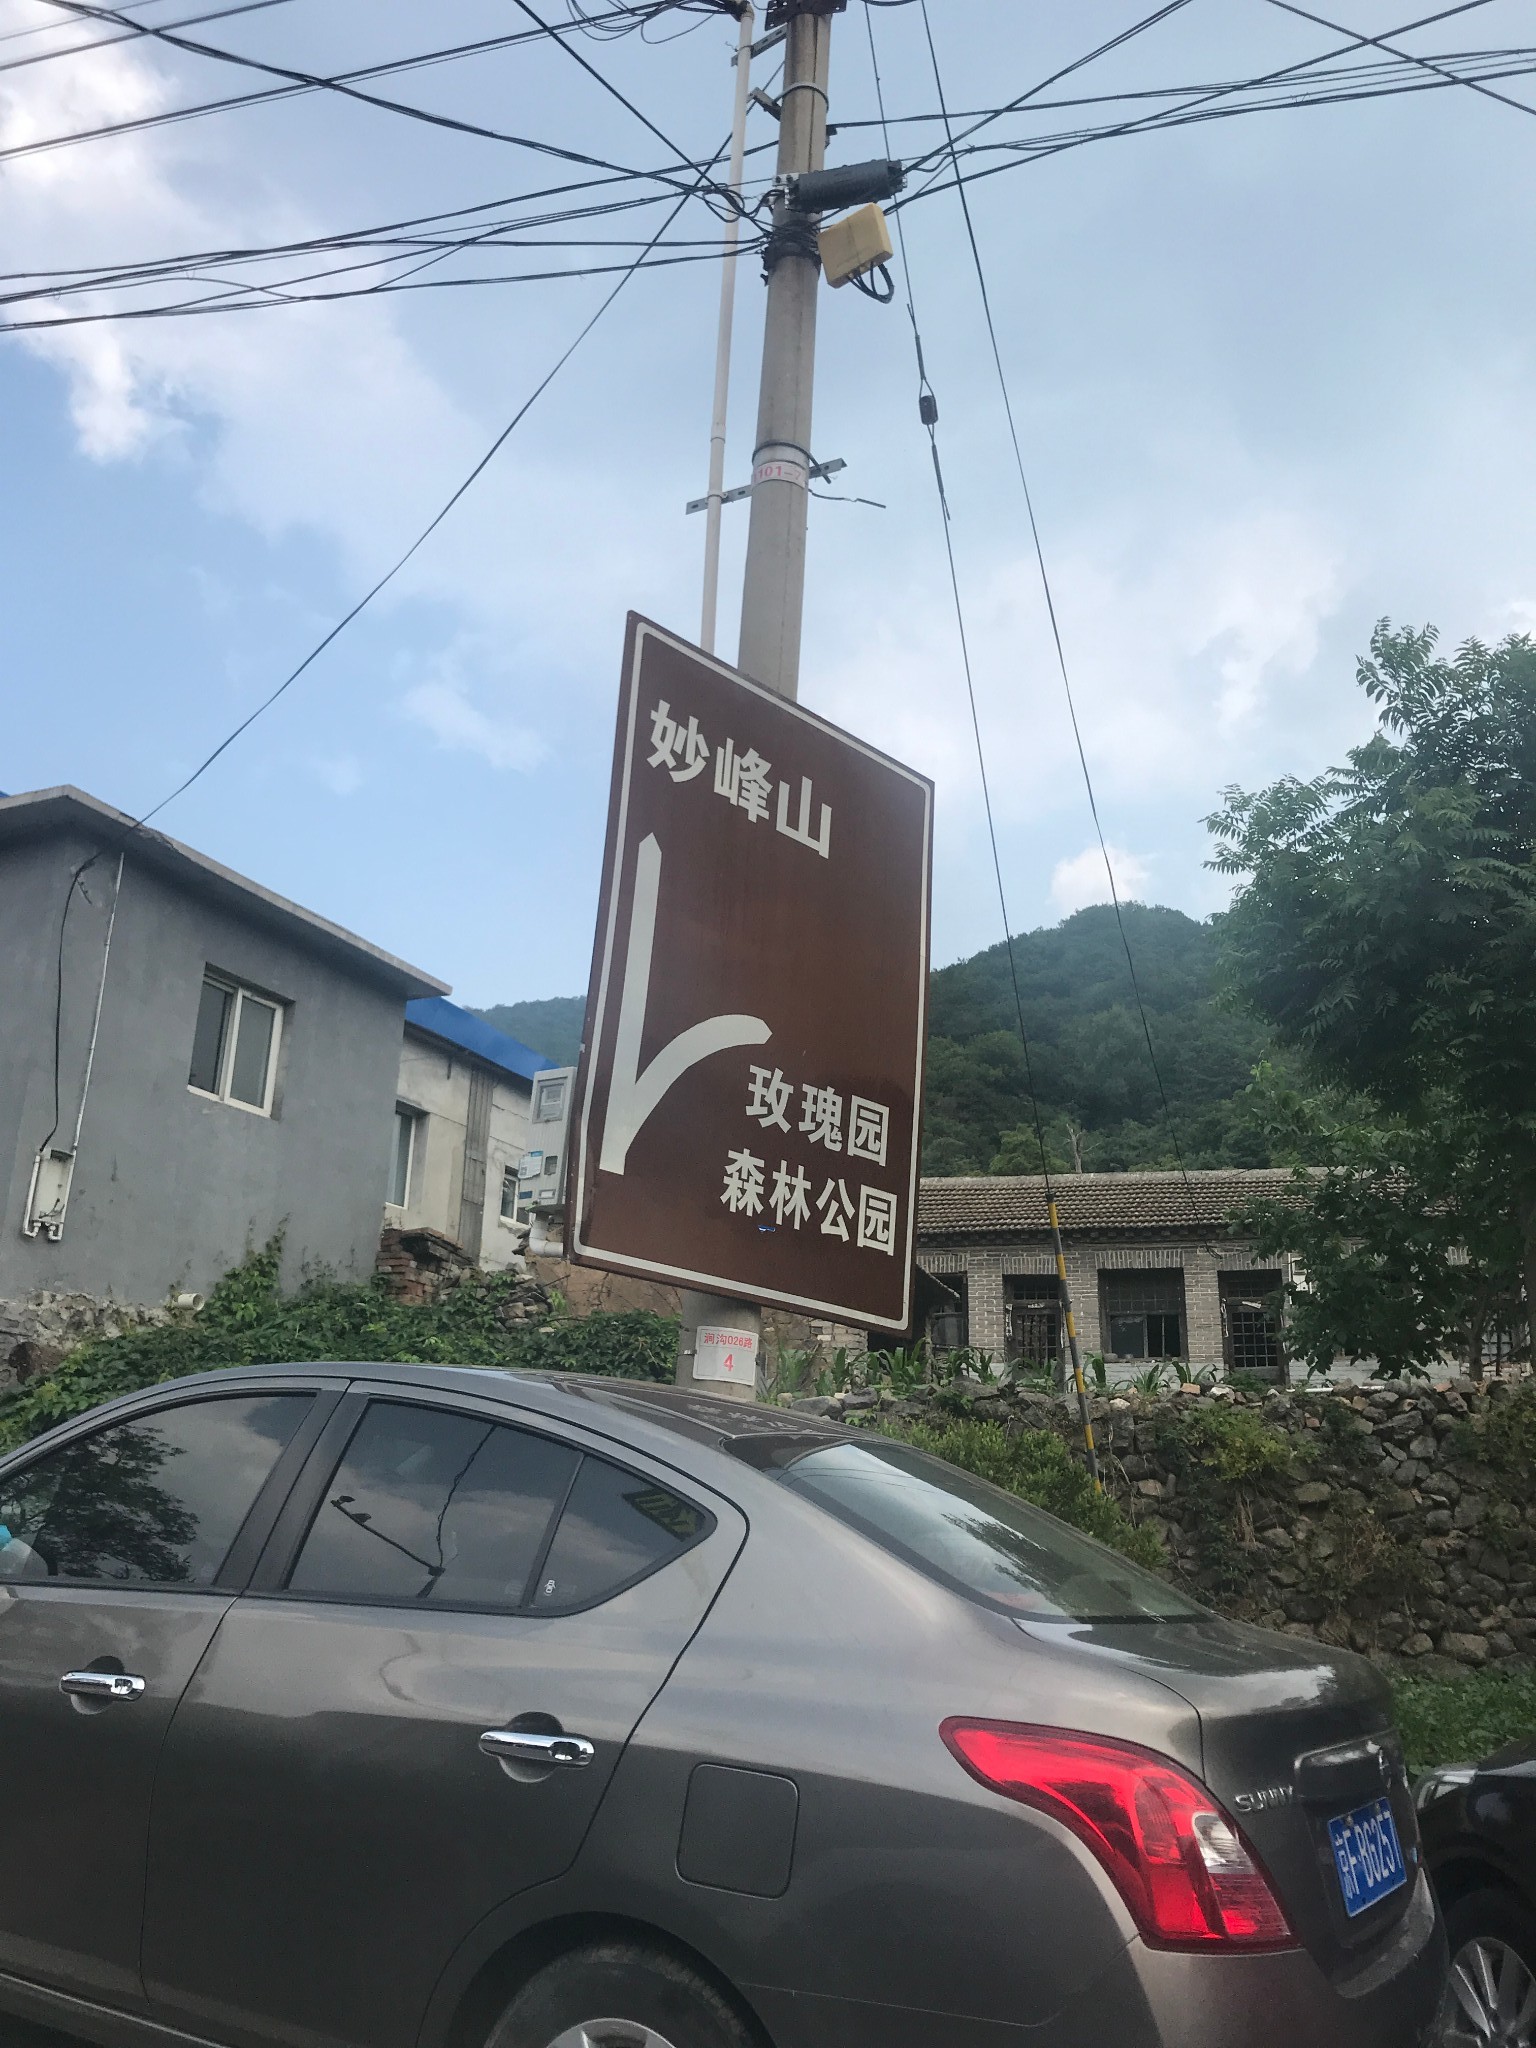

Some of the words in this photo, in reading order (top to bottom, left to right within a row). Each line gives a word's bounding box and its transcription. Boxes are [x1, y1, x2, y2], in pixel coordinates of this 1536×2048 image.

[646, 699, 832, 860] 妙峰山
[745, 1064, 890, 1167] 玫瑰园
[720, 1148, 897, 1256] 森林公园
[723, 1353, 734, 1373] 4
[1234, 1785, 1294, 1812] SUNNY
